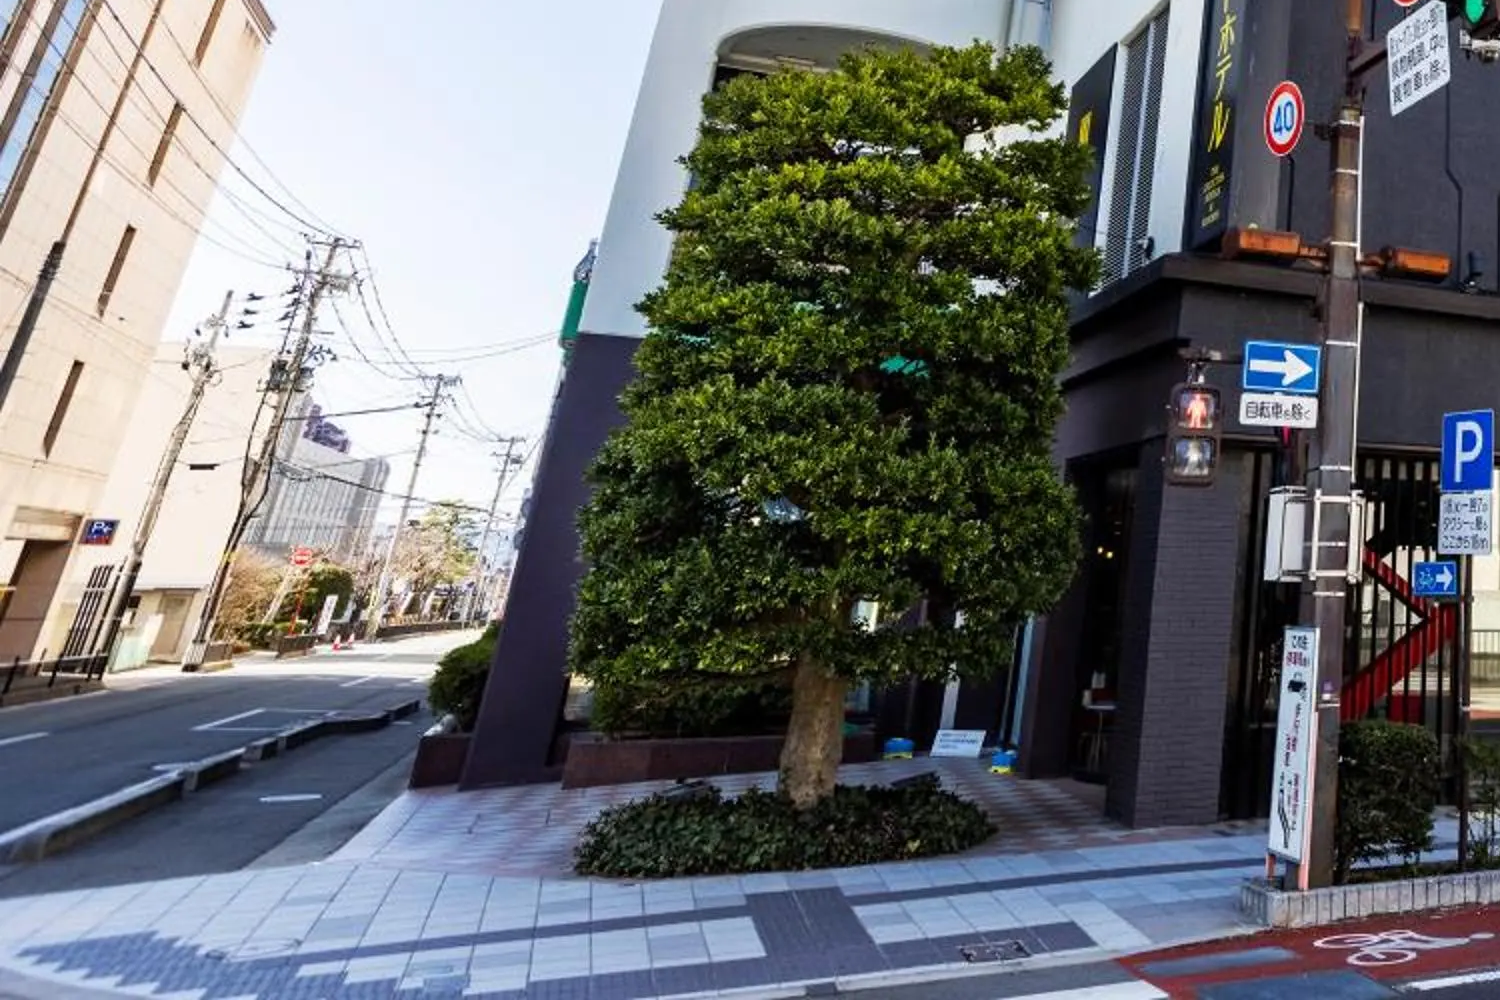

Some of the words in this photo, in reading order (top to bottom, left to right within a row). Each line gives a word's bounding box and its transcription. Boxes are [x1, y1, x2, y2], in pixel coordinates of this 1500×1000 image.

[1273, 101, 1295, 136] 40
[1245, 401, 1312, 421] 自転車を除く
[1454, 420, 1484, 484] P
